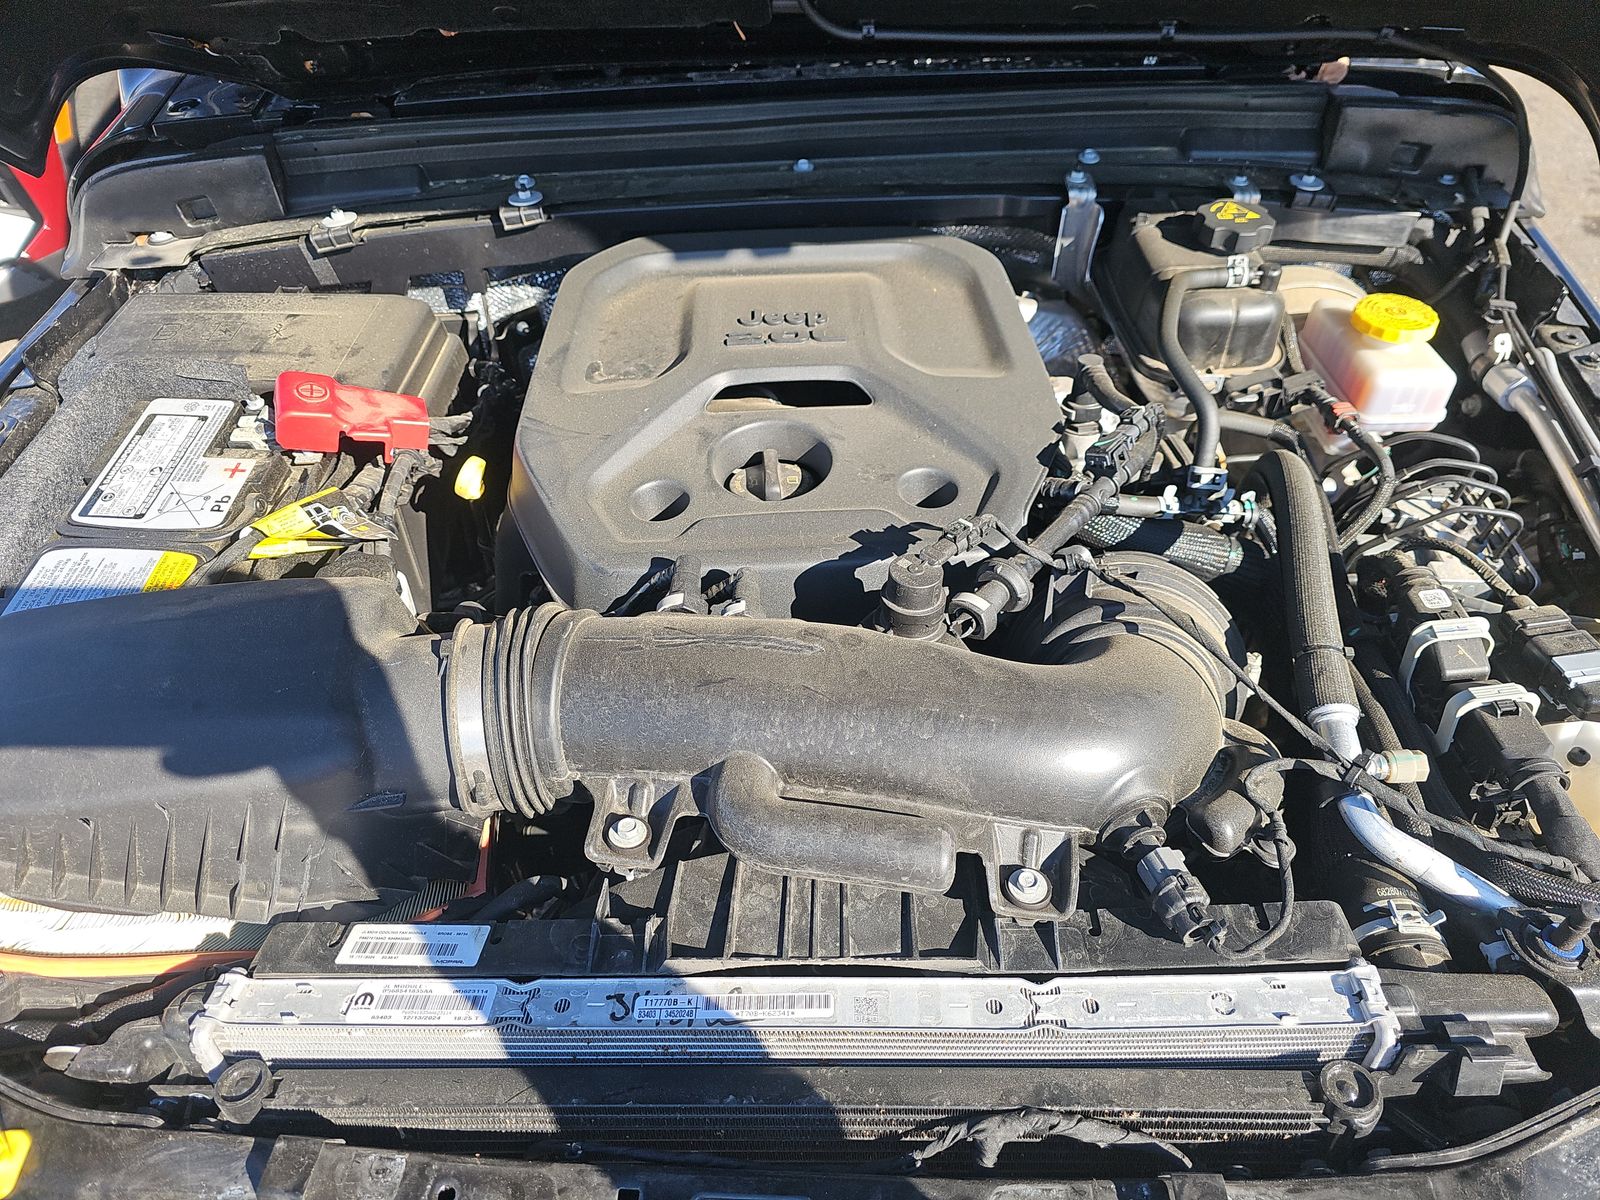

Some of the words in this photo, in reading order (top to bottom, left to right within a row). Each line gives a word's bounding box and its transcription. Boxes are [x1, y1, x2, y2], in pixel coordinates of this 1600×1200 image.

[736, 308, 829, 328] Jeep
[722, 329, 848, 347] 2.0L
[209, 495, 234, 514] Pb
[637, 1009, 657, 1018] 83403
